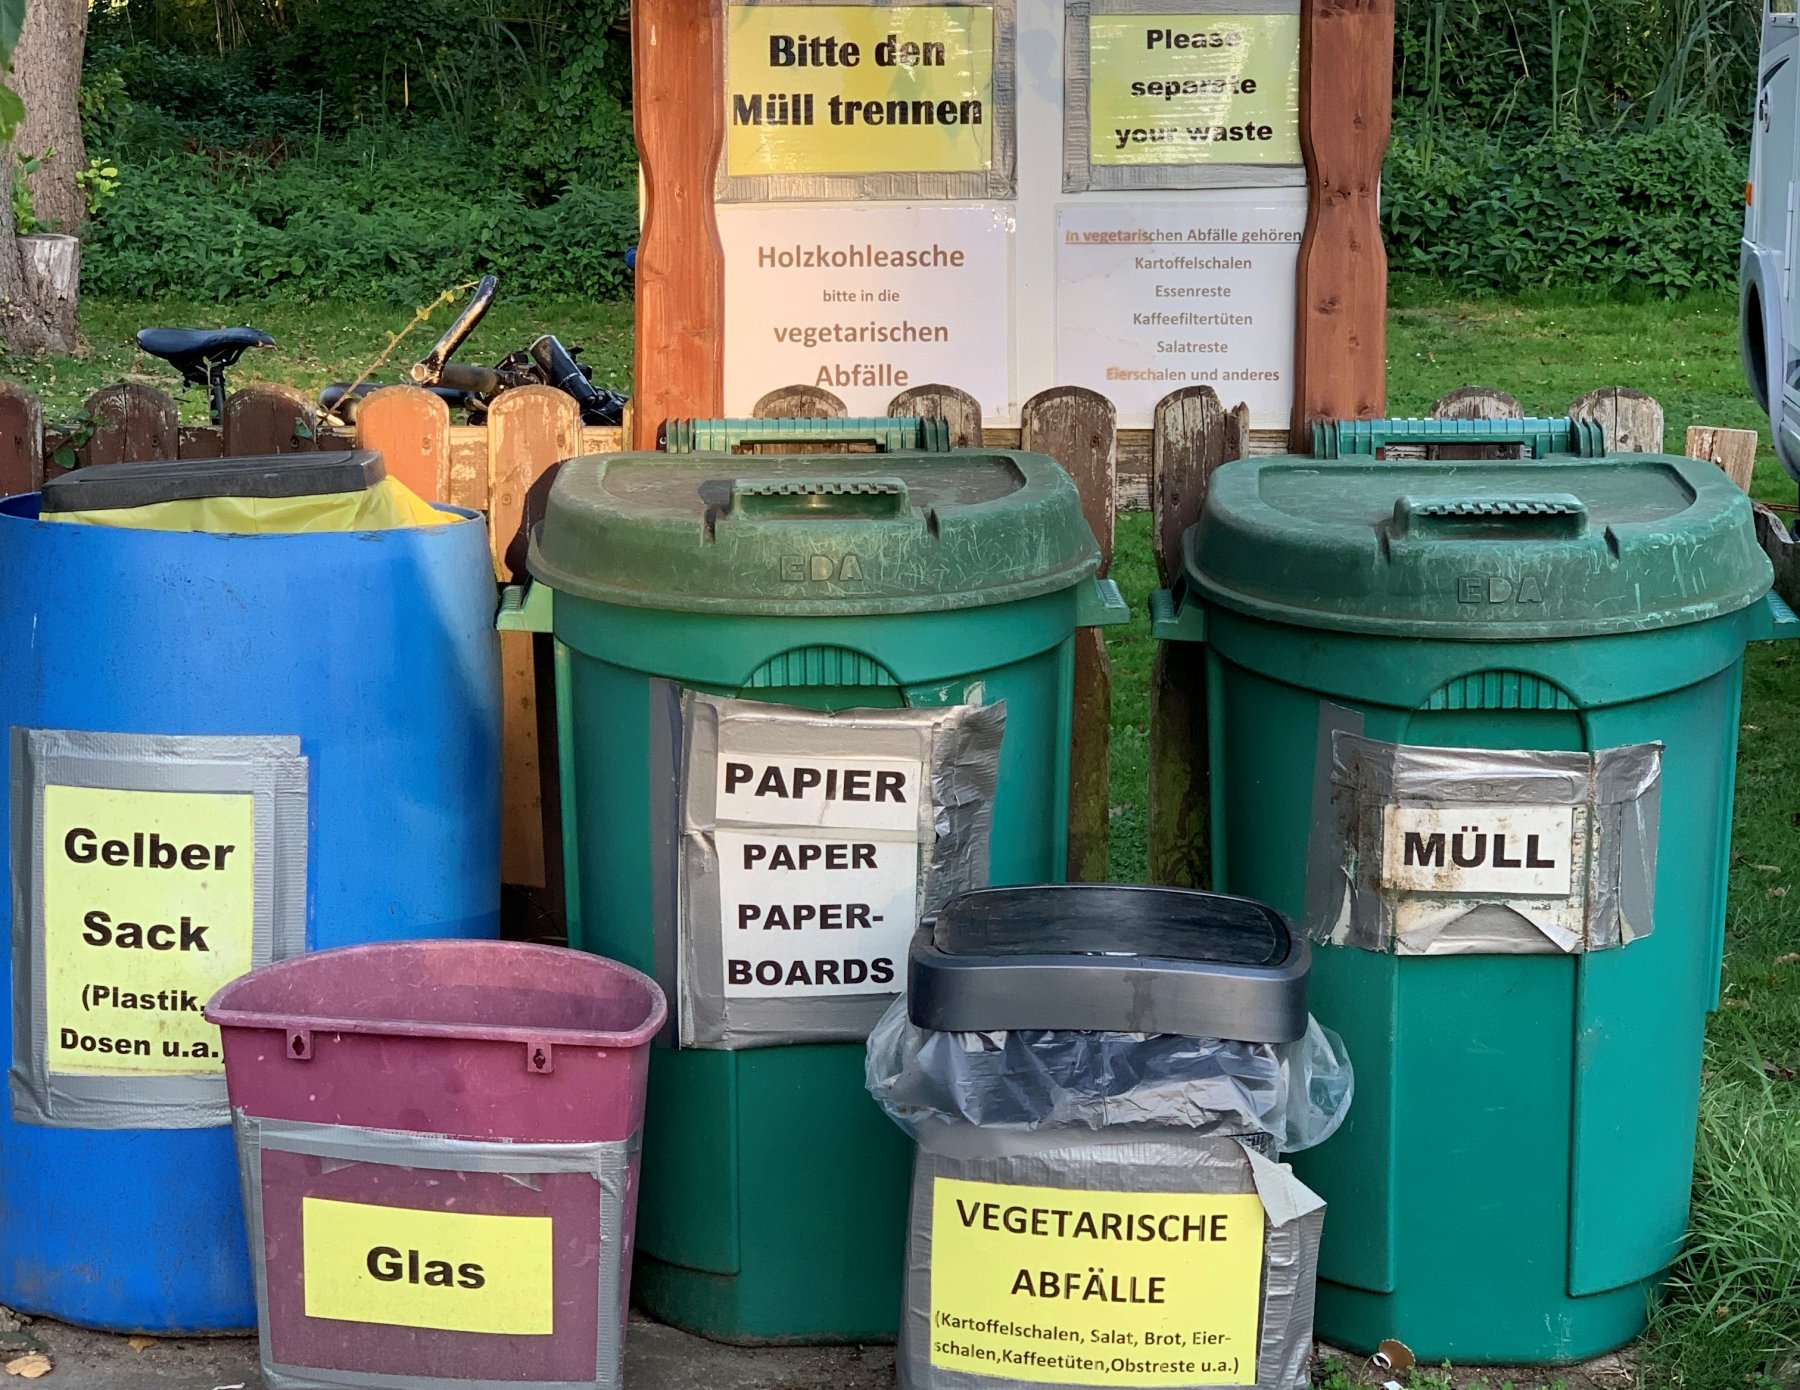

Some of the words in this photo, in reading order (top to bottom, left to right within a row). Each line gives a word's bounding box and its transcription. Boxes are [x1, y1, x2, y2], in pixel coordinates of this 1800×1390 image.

[769, 35, 861, 67] Bitte
[874, 35, 945, 66] den
[1146, 29, 1243, 49] Please
[1131, 75, 1257, 101] separate
[733, 94, 814, 125] Müll
[828, 97, 983, 125] trennen
[1115, 127, 1178, 149] your
[1186, 121, 1273, 142] waste
[1065, 230, 1079, 242] In
[1083, 229, 1183, 243] vegetarischen
[1187, 229, 1238, 242] Abfälle
[1242, 229, 1302, 243] gehören
[757, 245, 965, 268] Holzkohleasche
[1135, 257, 1252, 270] Kartoffelschalen
[822, 290, 857, 303] bitte
[860, 290, 874, 303] in
[877, 290, 900, 303] die
[1155, 285, 1231, 298] Essenreste
[1133, 313, 1253, 326] Kaffeefiltertüten
[773, 321, 949, 348] vegetarischen
[1156, 341, 1228, 353] Salatreste
[815, 364, 909, 387] Abfälle
[1106, 368, 1187, 381] Eierschalen
[1191, 368, 1218, 381] und
[1222, 368, 1279, 381] anderes
[780, 555, 863, 581] EDA
[1458, 577, 1542, 603] EDA
[725, 762, 907, 803] PAPIER
[65, 828, 235, 871] Gelber
[743, 844, 878, 870] PAPER
[1404, 826, 1555, 869] MÜLL
[738, 904, 884, 930] PAPER-
[83, 911, 210, 952] Sack
[728, 958, 894, 986] BOARDS
[60, 1028, 151, 1057] Dosen
[162, 1041, 225, 1064] u.a.
[957, 1199, 1228, 1242] VEGETARISCHE
[366, 1246, 486, 1289] Glas
[1011, 1267, 1166, 1304] ABFÄLLE
[935, 1310, 1085, 1344] (Kartoffelschalen,
[1090, 1328, 1139, 1347] Salat,
[1144, 1332, 1187, 1348] Brot,
[1192, 1331, 1232, 1345] Eier-
[1201, 1357, 1240, 1374] u.a.)
